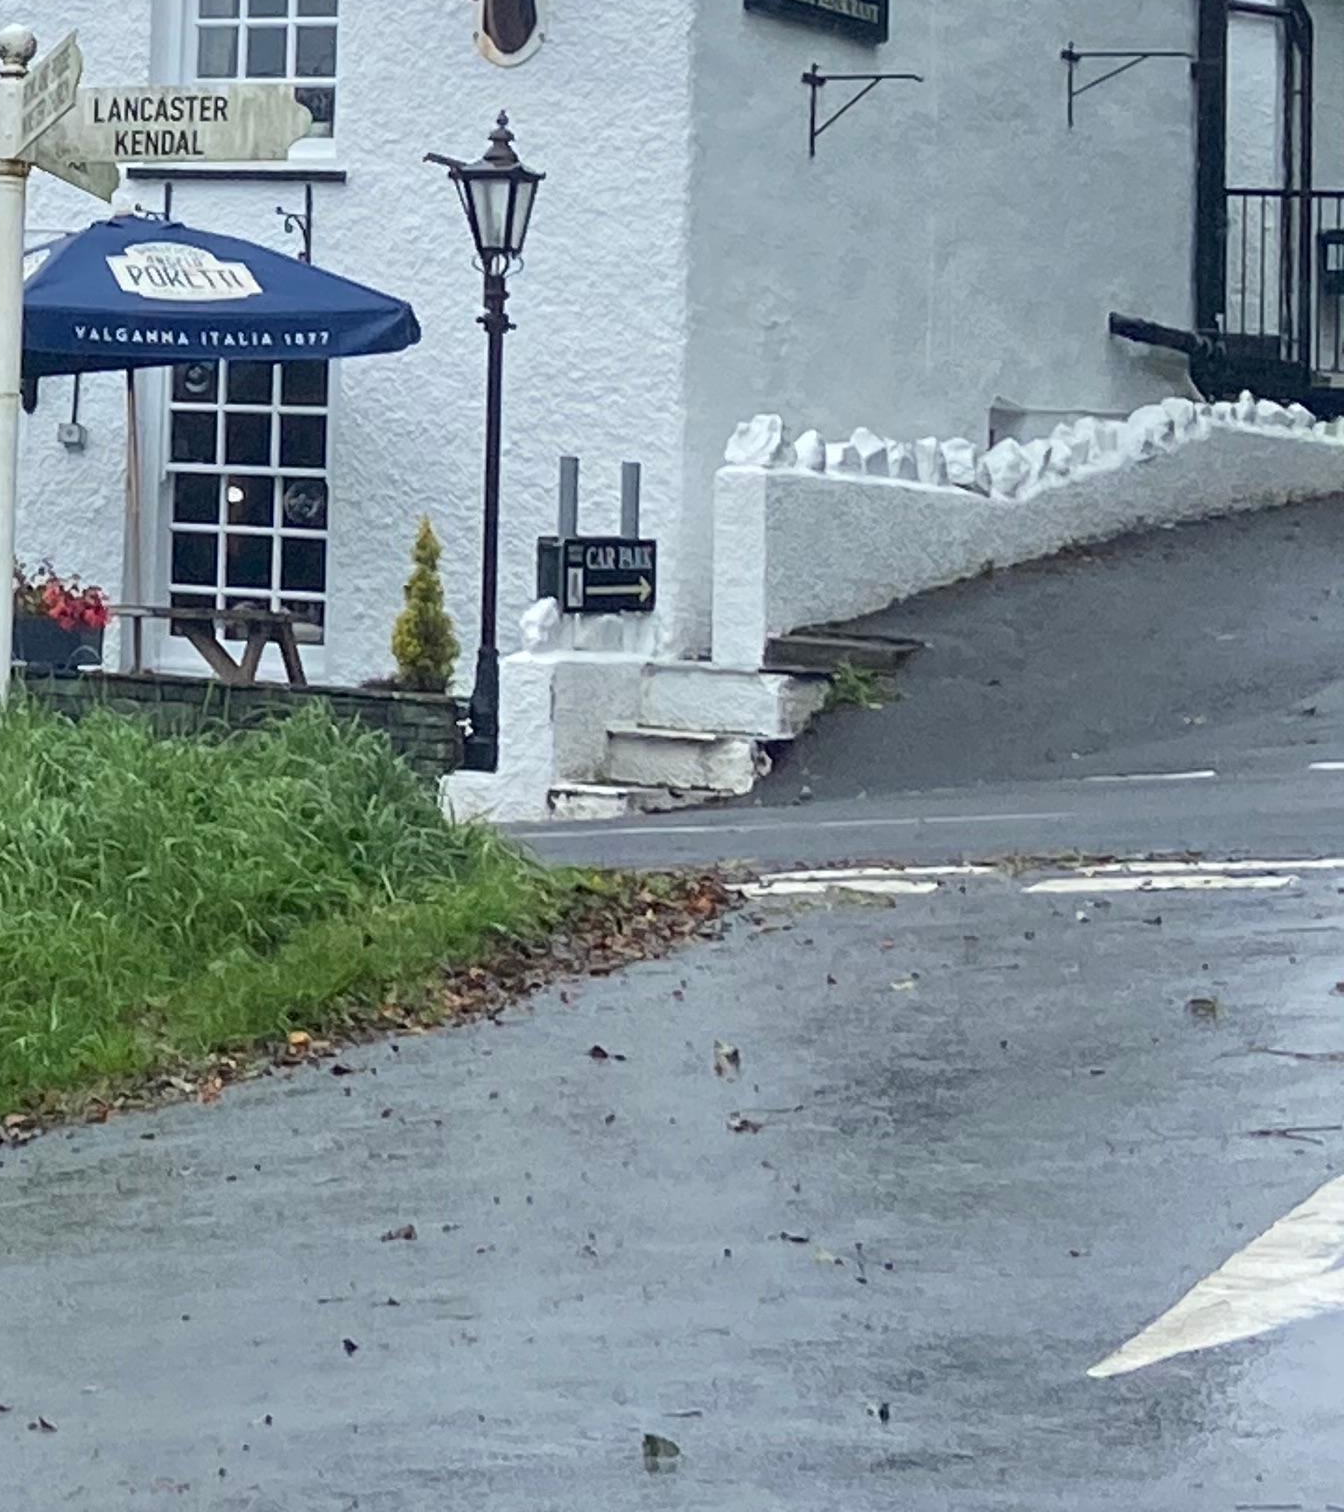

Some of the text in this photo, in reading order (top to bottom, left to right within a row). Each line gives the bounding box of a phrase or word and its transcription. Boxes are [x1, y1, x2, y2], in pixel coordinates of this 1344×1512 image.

[93, 96, 228, 123] LANCASTER
[114, 130, 204, 156] KENDAL
[74, 325, 189, 346] VALGANNA
[200, 330, 273, 346] ITALIA
[586, 546, 616, 570] CAR
[618, 546, 653, 570] PARK
